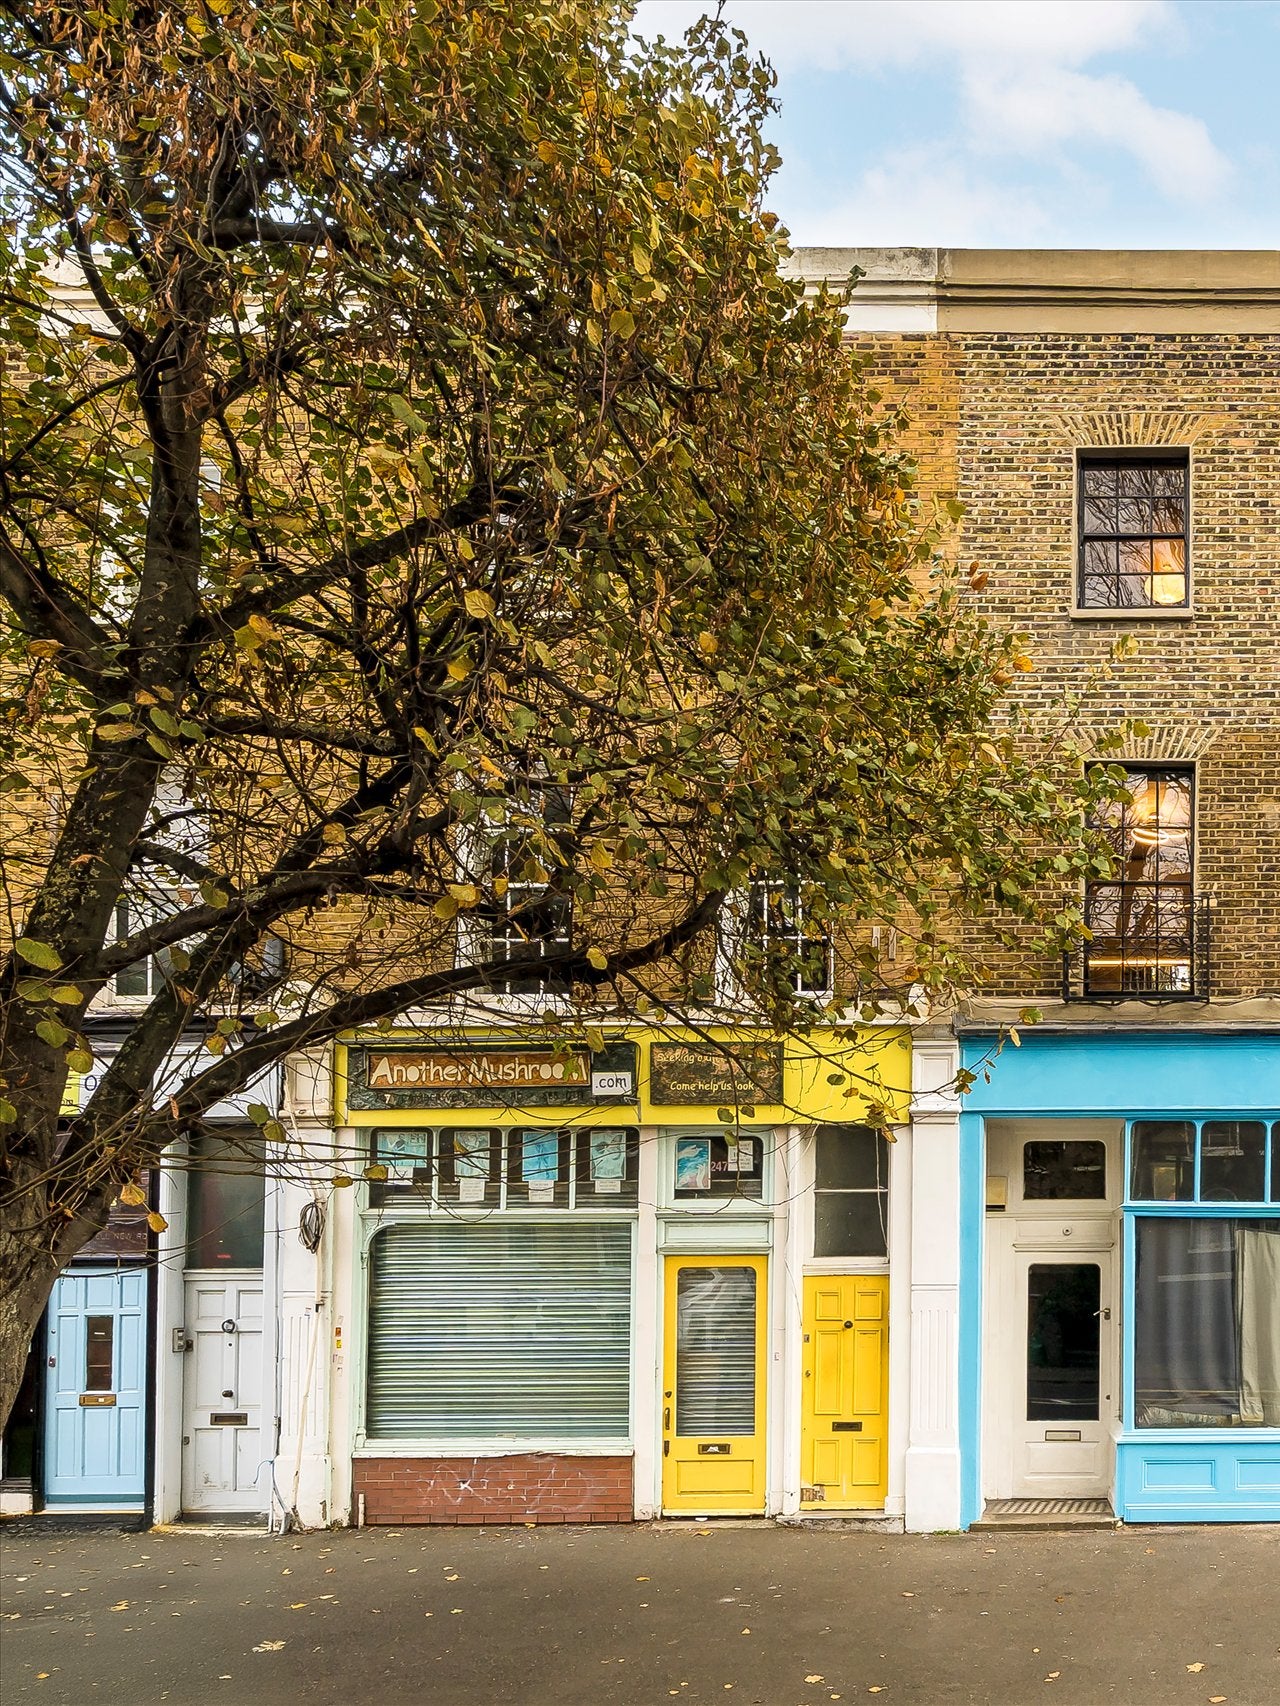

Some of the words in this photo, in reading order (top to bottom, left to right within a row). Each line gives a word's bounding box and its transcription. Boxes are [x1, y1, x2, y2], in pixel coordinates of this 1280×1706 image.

[670, 1081, 696, 1091] Come
[698, 1081, 719, 1092] help
[711, 1161, 728, 1172] 247
